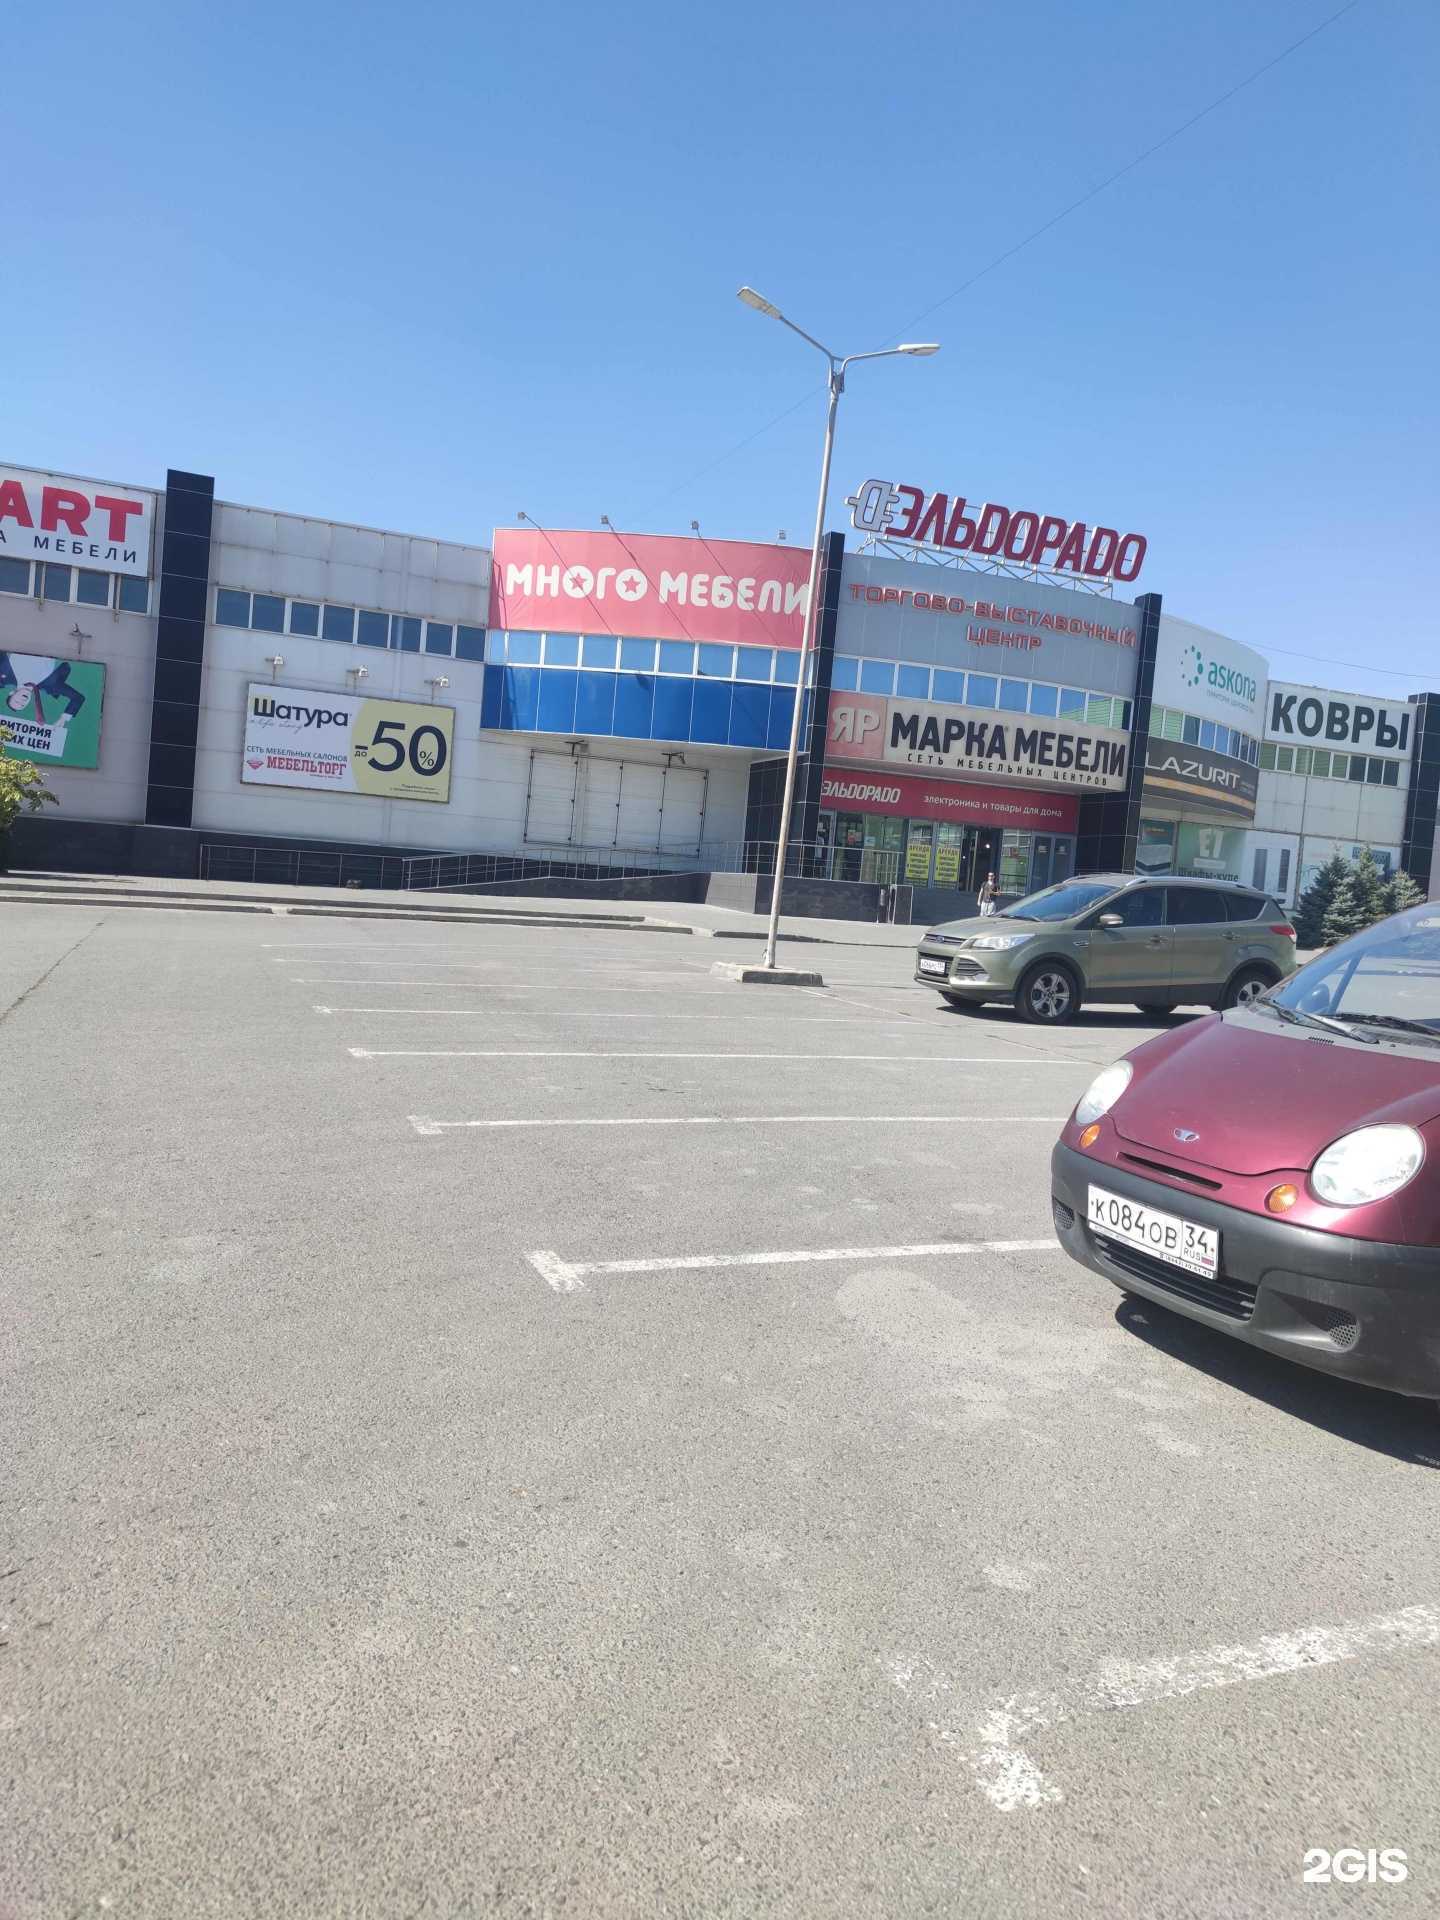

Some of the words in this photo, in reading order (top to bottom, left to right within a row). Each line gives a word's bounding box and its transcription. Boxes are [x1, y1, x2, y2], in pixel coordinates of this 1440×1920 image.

[0, 480, 143, 543] ART
[33, 535, 137, 564] МЕБЕЛИ
[506, 563, 648, 602] МНОГО
[658, 570, 811, 617] МЕБЕЛИ
[848, 583, 1137, 648] ТОРГОВО-ВЫСТАВОЧНЫЙ
[966, 624, 1042, 650] ЦЕНТР
[1207, 661, 1257, 702] askona
[253, 697, 349, 729] Шатура
[1271, 692, 1410, 751] КОВРЫ
[27, 737, 51, 751] ЦЕН
[246, 745, 264, 754] СЕТЬ
[265, 747, 311, 757] МЕБЕЛЬНЫХ
[890, 711, 1007, 760] МАРКА
[1013, 727, 1126, 777] МЕБЕЛИ
[266, 755, 347, 776] МЕБЕЛЬТОРГ
[907, 753, 944, 766] СЕТЬ
[957, 759, 1042, 777] МЕБЕЛЬНЫХ
[1053, 772, 1107, 786] ЦЕНТРОВ
[1144, 751, 1241, 789] LAZURIT
[924, 795, 980, 809] электроника
[990, 803, 1022, 813] товары
[1023, 806, 1039, 816] для
[1183, 1247, 1201, 1261] RUS
[1185, 1225, 1209, 1254] 34
